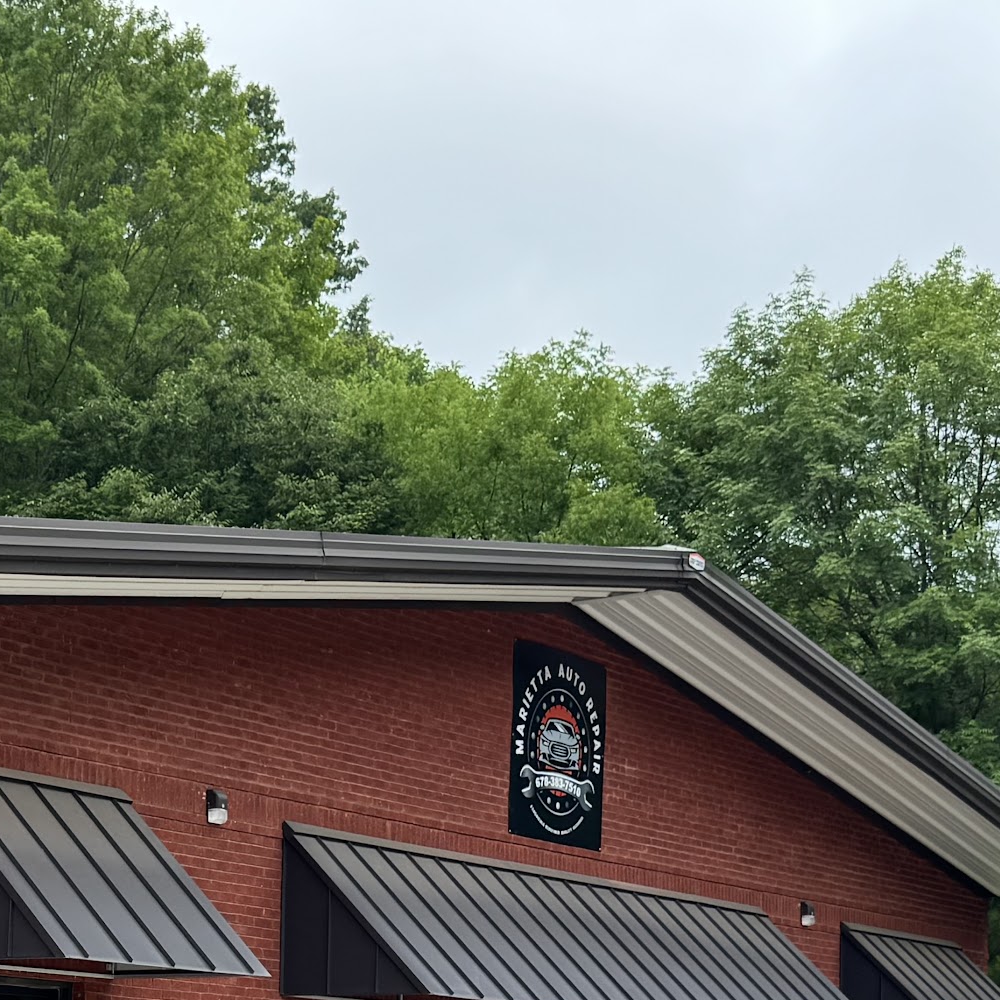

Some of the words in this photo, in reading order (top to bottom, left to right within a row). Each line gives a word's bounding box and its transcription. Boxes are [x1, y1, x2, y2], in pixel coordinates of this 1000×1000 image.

[515, 665, 552, 755] MARIETTA
[558, 663, 587, 696] AUTO
[585, 697, 602, 775] REPAIR
[535, 776, 581, 798] 678-383-7510
